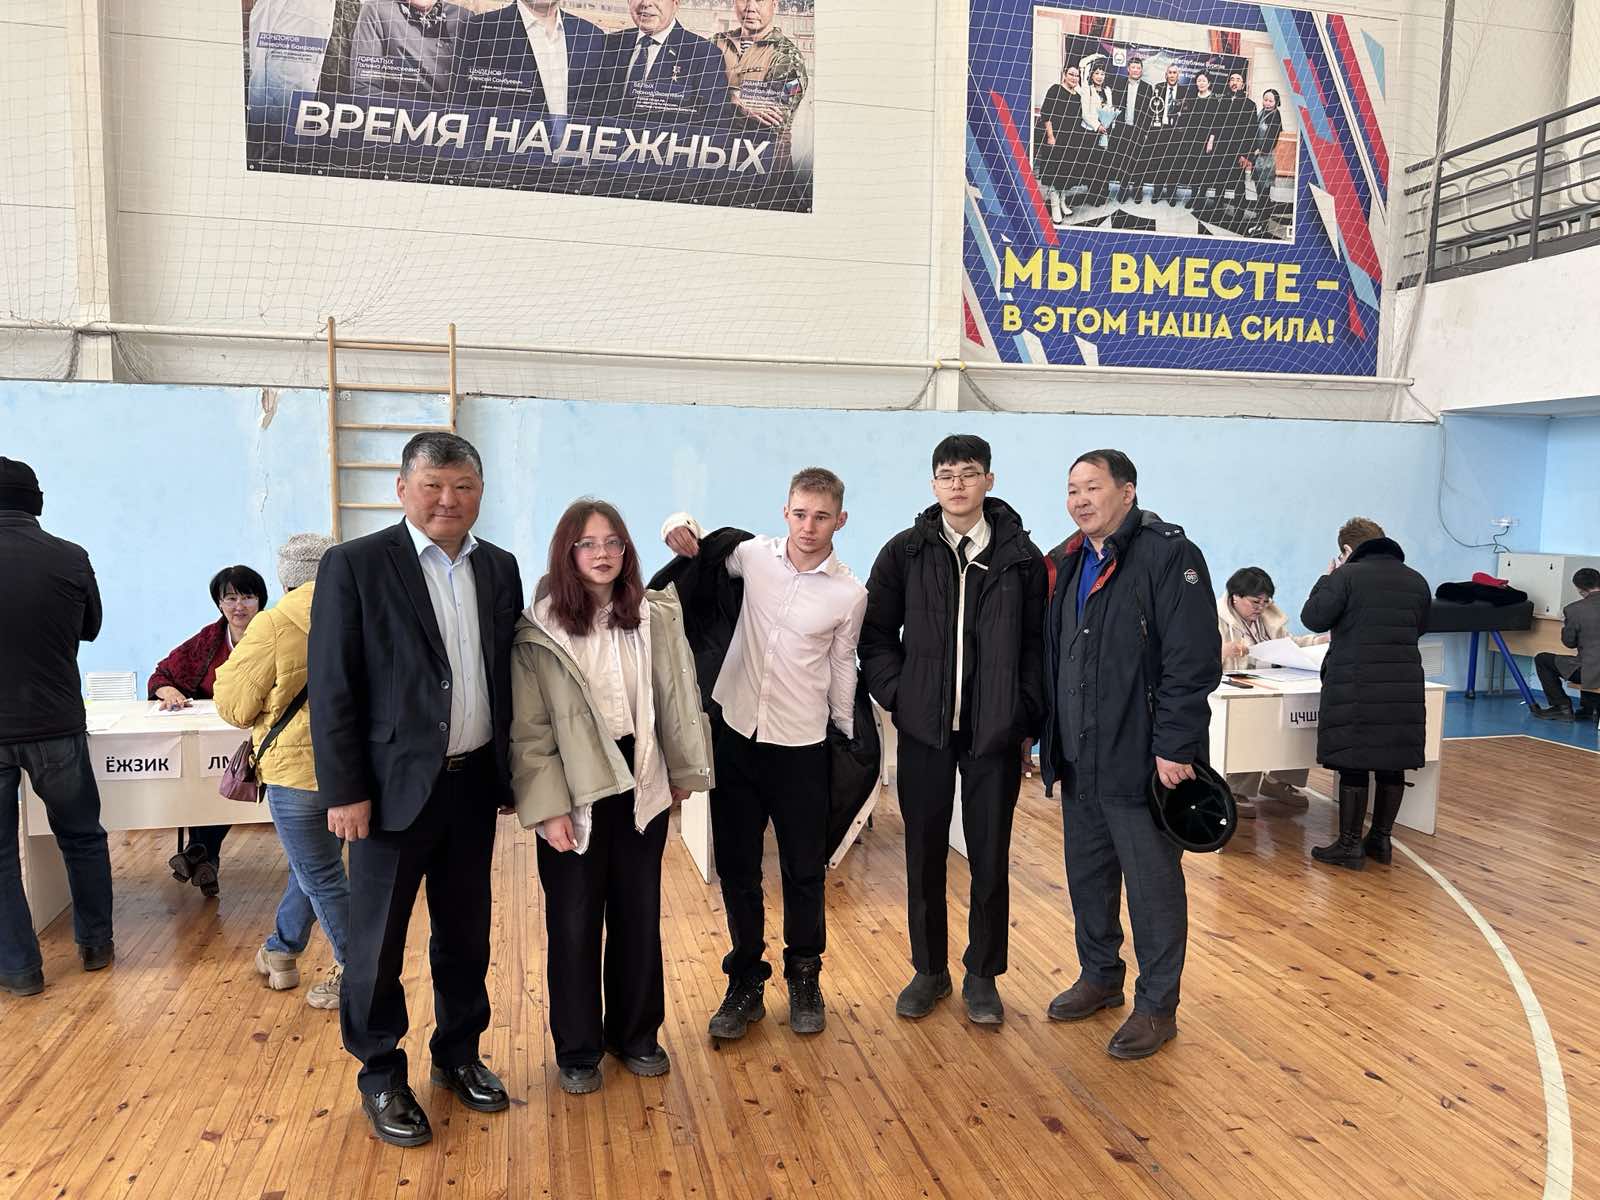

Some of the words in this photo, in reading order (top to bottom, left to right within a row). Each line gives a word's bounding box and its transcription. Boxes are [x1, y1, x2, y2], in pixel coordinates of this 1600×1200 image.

[294, 100, 470, 149] ВРЕМЯ
[484, 116, 771, 175] НАДЕЖНЫХ
[1003, 246, 1093, 292] МЫ
[1110, 253, 1301, 303] ВМЕСТЕ
[1002, 305, 1022, 332] В
[1033, 306, 1127, 335] ЭТОМ
[1138, 310, 1233, 340] НАША
[1240, 315, 1335, 344] СИЛА!
[1290, 711, 1320, 725] ЦЧШ
[105, 755, 169, 773] ЁЖЗИК
